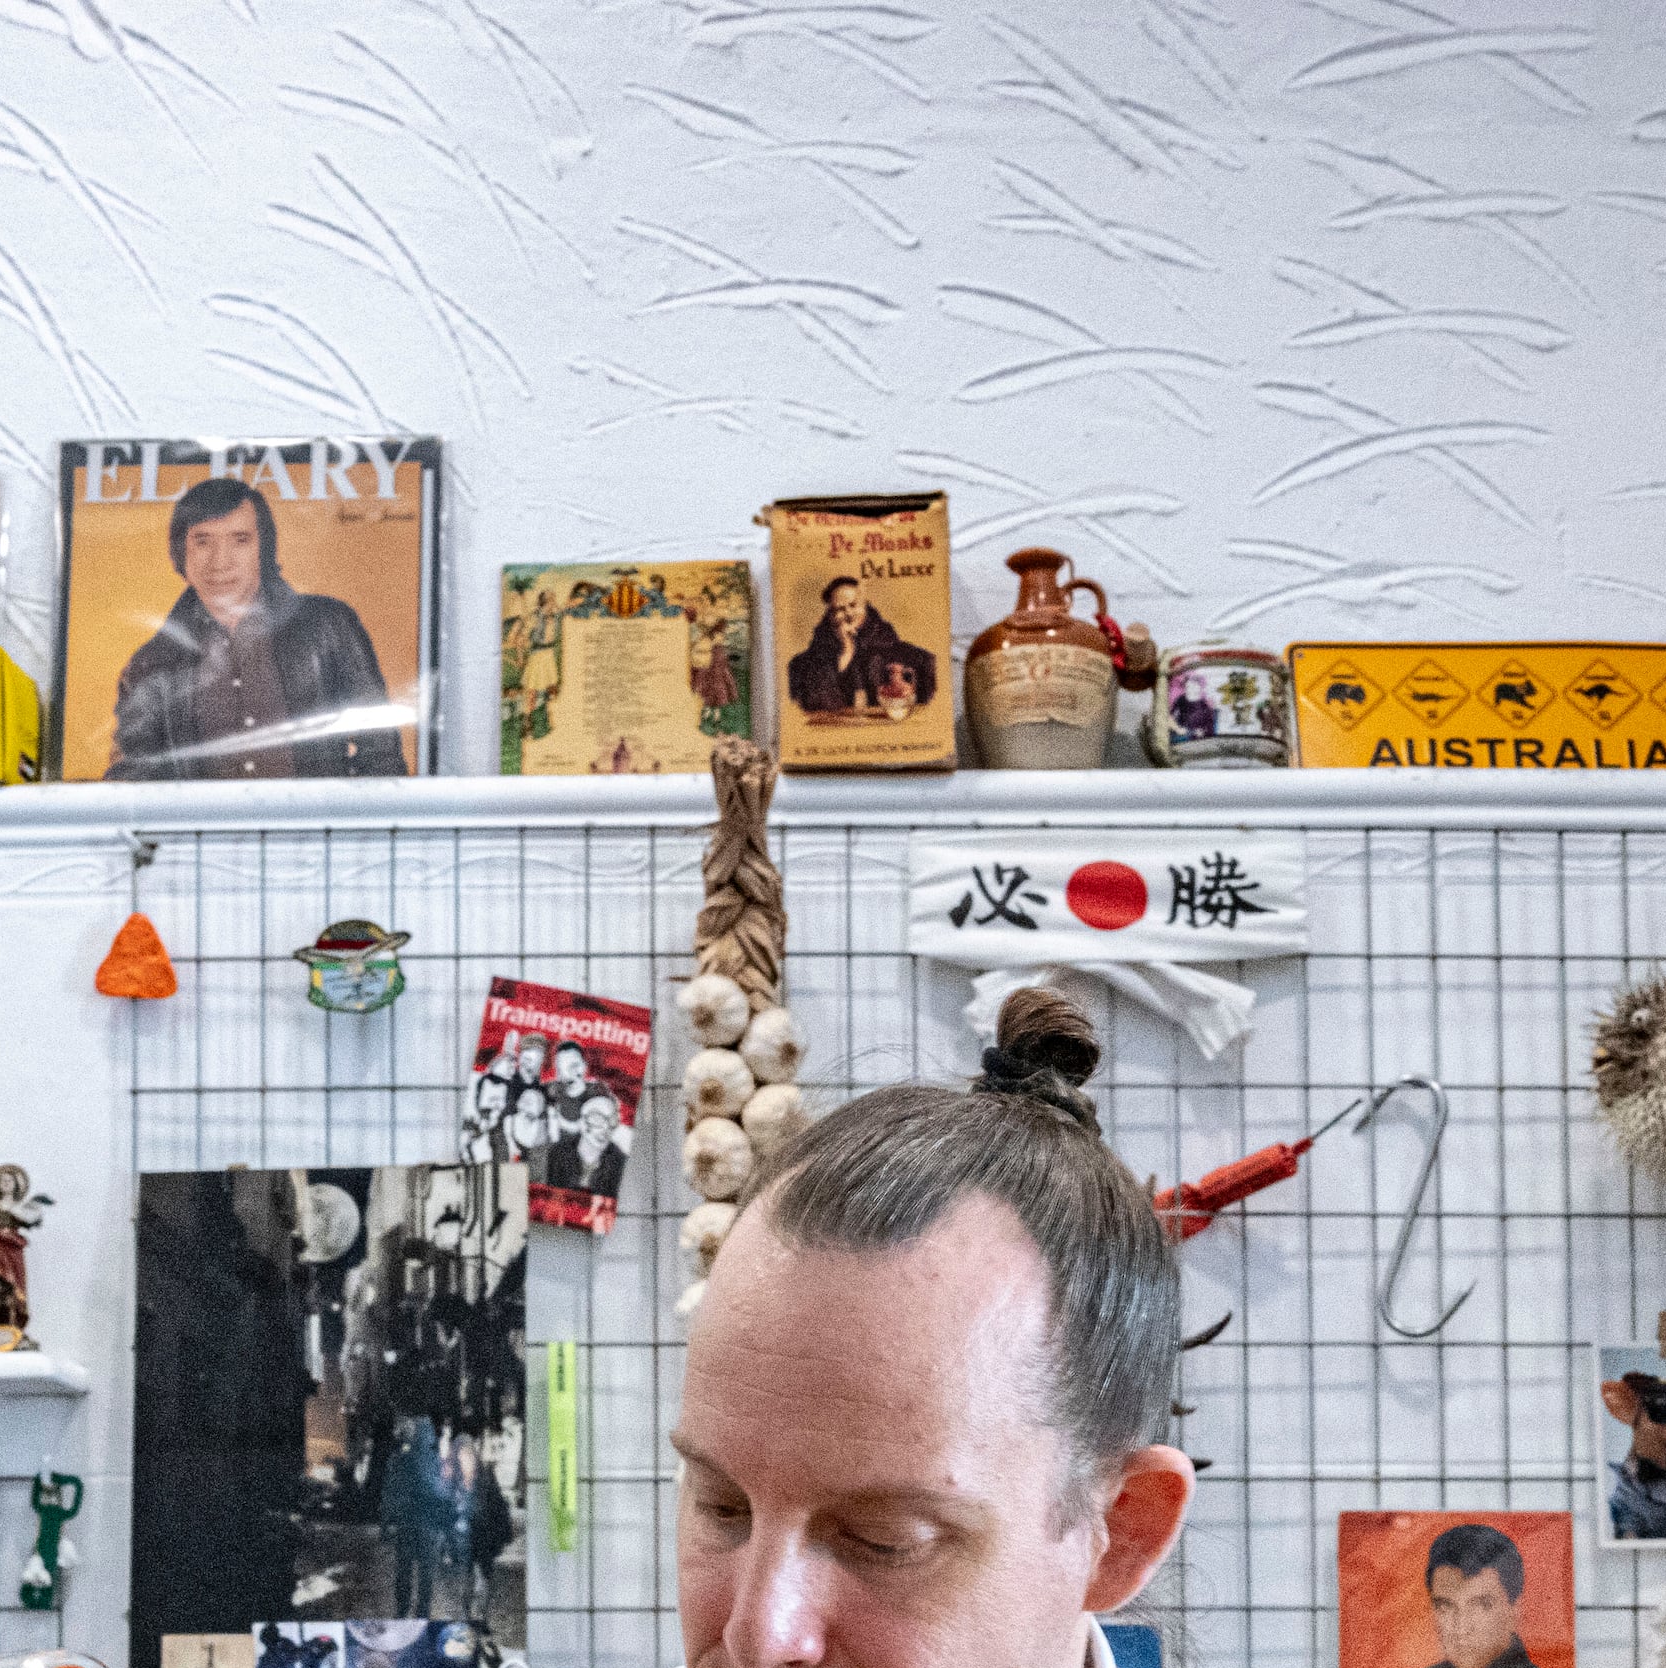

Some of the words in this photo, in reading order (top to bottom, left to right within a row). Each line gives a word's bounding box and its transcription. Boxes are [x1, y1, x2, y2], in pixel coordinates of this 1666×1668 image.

[84, 441, 188, 503] EL
[948, 861, 1049, 931] 必
[1165, 848, 1280, 931] 勝
[489, 998, 651, 1055] Trainspotting
